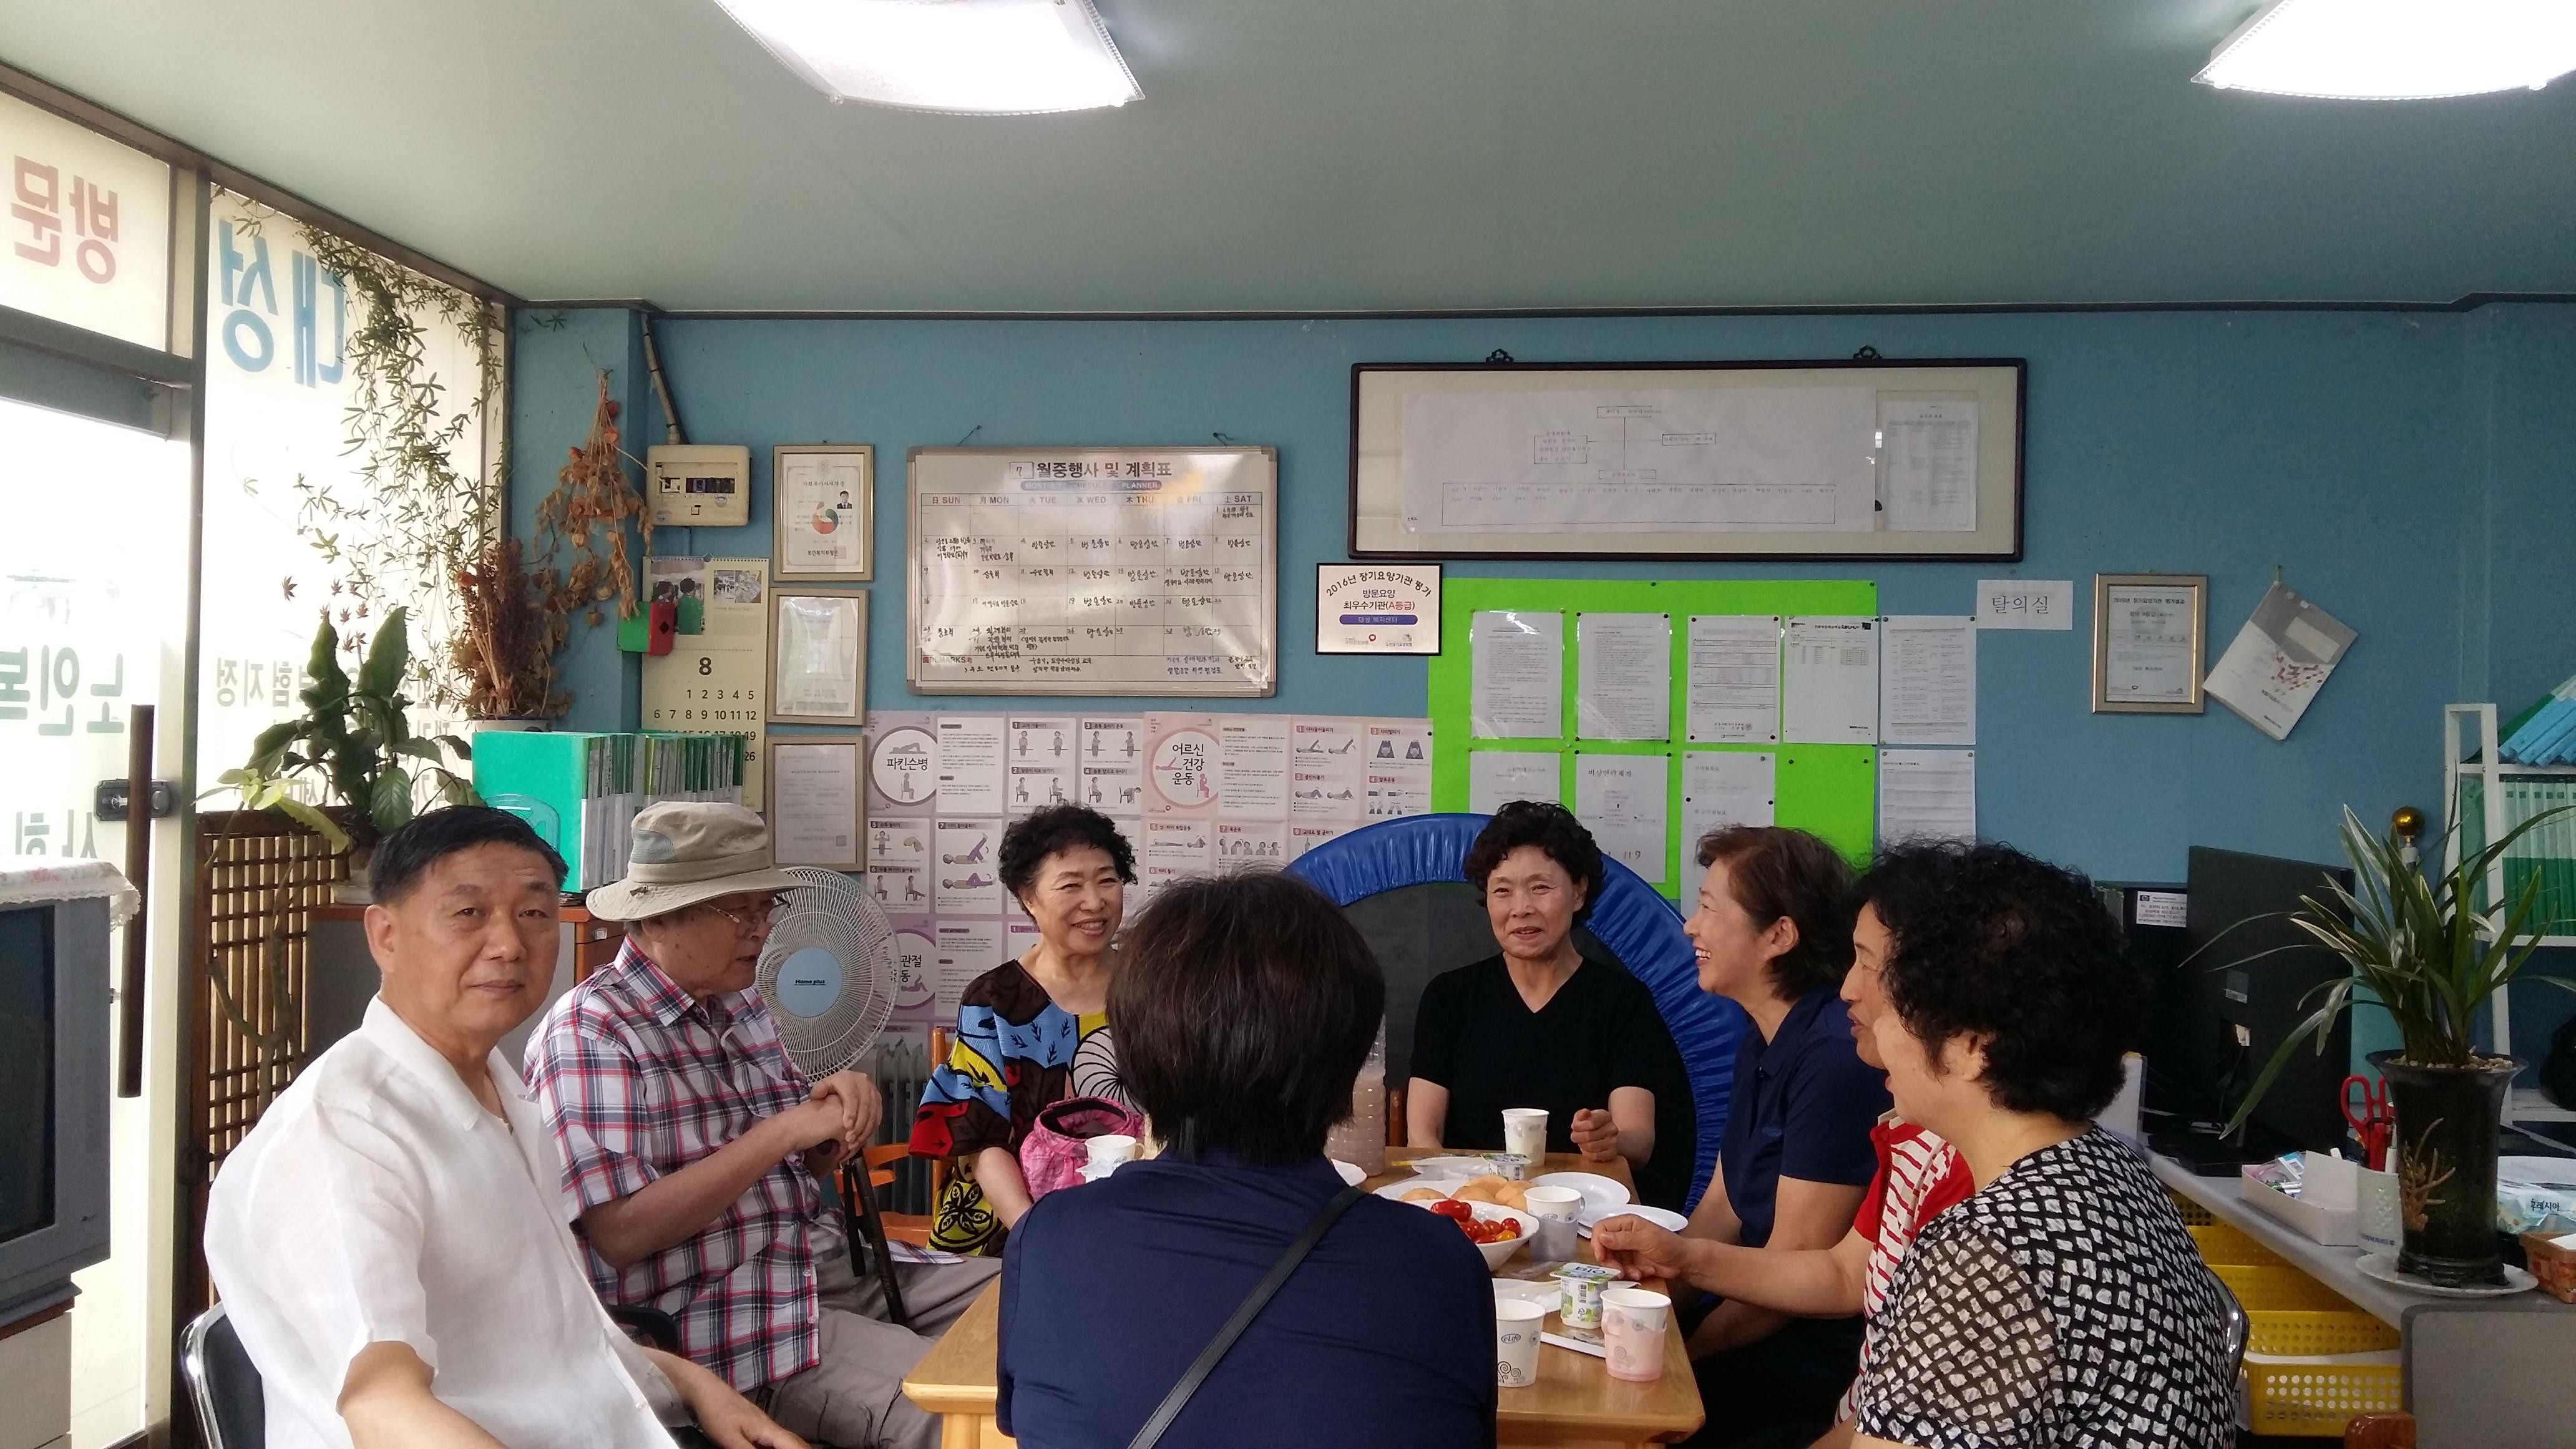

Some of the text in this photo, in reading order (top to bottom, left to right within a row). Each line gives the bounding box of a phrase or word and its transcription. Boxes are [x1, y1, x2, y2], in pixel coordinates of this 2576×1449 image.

[1037, 461, 1172, 478] 월중행사 및 계획표
[1121, 481, 1158, 489] PLANNER
[1326, 571, 1432, 597] 2016년 장기요양기관 평가
[1362, 589, 1396, 598] 방문요양
[1344, 600, 1415, 610] 최우수기관(A등급)
[1991, 595, 2049, 615] 탈의실
[699, 657, 712, 676] 8
[687, 690, 754, 700] 1 2 3 4 5
[654, 710, 756, 720] 6 7 8 9 10 11 12
[745, 731, 756, 740] 19
[1171, 743, 1204, 757] 어르신
[744, 752, 755, 761] 26
[886, 757, 929, 771] 파킨슨병
[1183, 758, 1205, 772] 건강
[1171, 772, 1195, 786] 운동
[1623, 851, 1641, 861] 119
[1574, 1266, 1606, 1274] BIO
